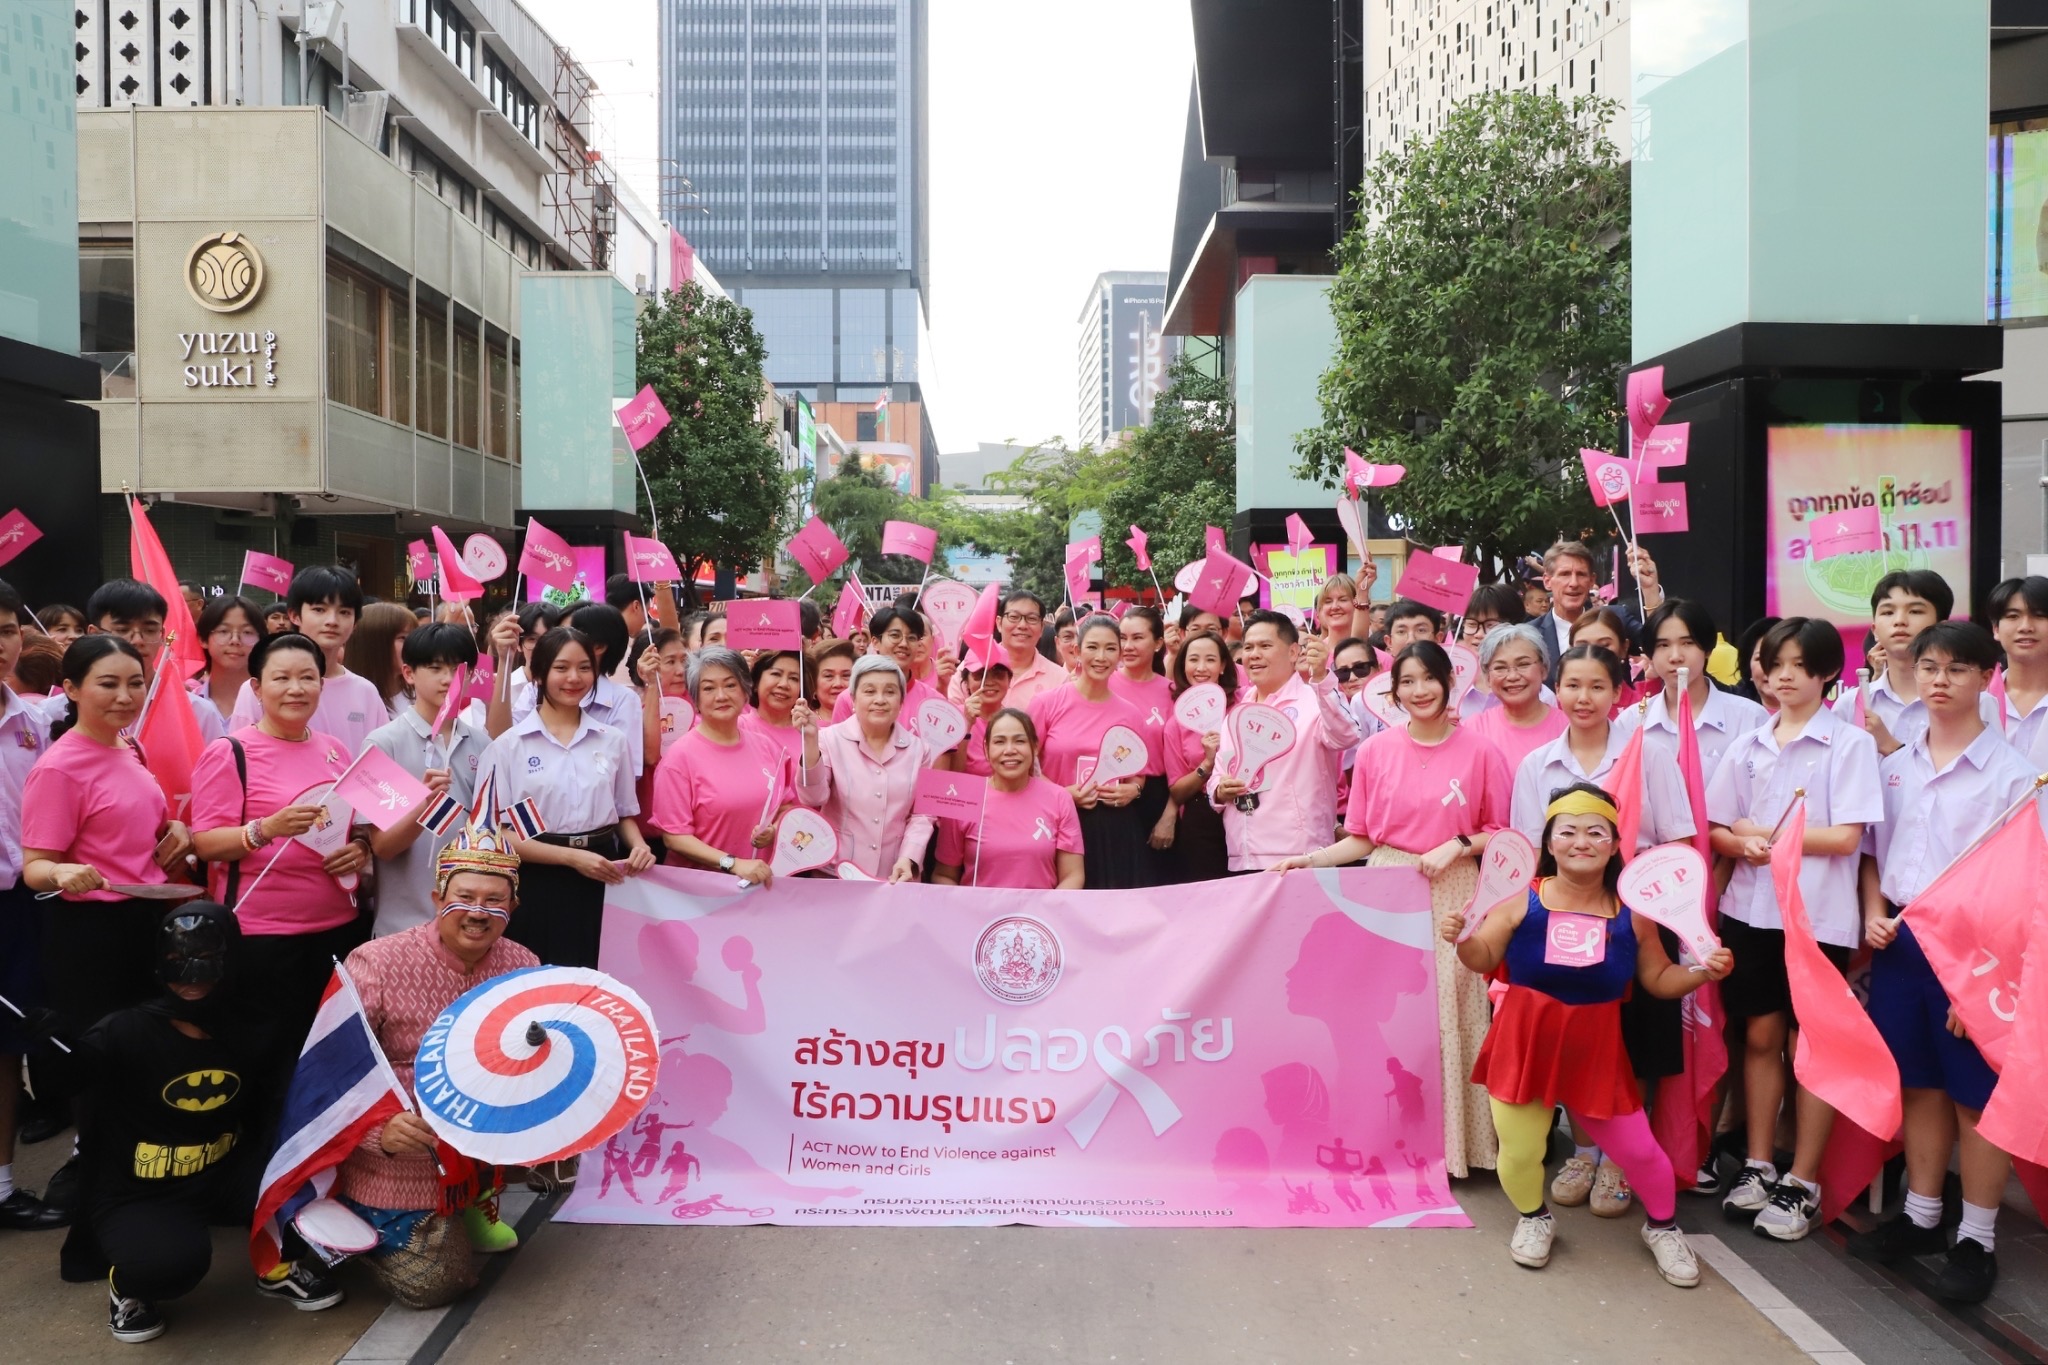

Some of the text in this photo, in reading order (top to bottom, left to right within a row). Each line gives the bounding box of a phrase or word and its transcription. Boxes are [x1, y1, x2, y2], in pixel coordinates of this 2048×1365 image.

[178, 332, 260, 361] yuzu
[264, 330, 277, 387] ゆずすき
[184, 357, 257, 387] suki
[1129, 332, 1161, 409] PRO
[1880, 480, 1951, 508] ถ้าช้อป
[1898, 520, 1959, 551] 11.11
[472, 546, 496, 569] STP
[933, 600, 965, 611] STP
[1186, 697, 1216, 719] STP
[926, 713, 955, 734] STP
[1246, 720, 1282, 741] STP
[1492, 851, 1521, 880] STP
[590, 994, 651, 1101] THAILAND
[794, 1028, 945, 1080] สร้างสุข
[419, 1014, 480, 1128] THAILAND
[791, 1080, 1057, 1134] ไร้ความรุนแรง
[802, 1141, 1056, 1161] ACT NOW to End Violence against
[801, 1157, 931, 1176] Women and Girls
